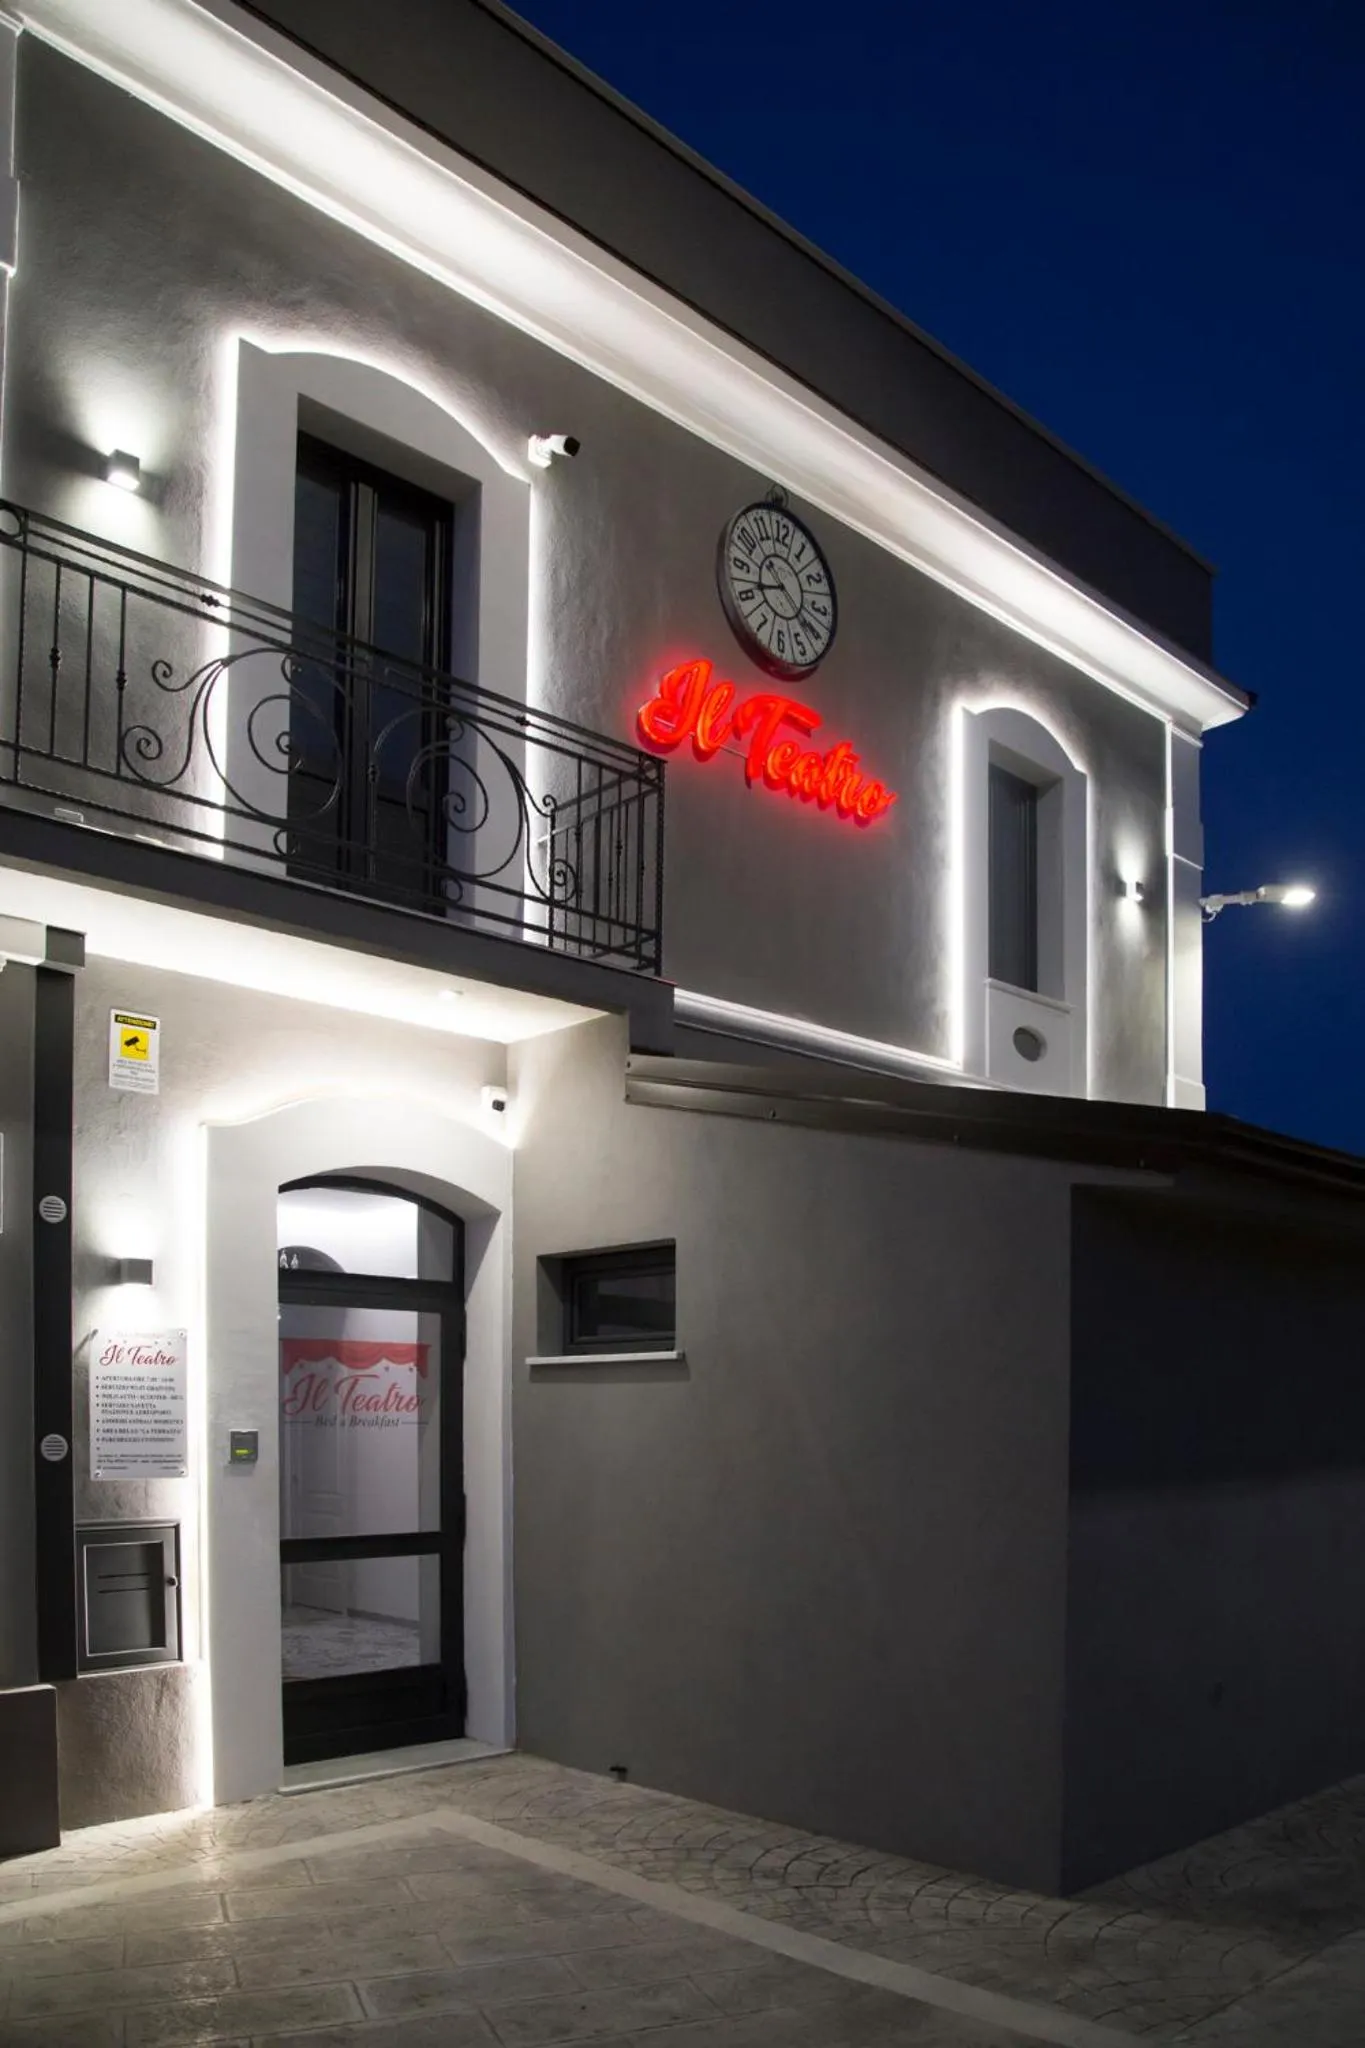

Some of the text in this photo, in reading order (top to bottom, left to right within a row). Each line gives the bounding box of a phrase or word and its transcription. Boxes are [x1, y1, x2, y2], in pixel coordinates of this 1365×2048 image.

[754, 517, 771, 541] 11
[775, 519, 790, 547] 12
[737, 528, 757, 556] 10
[794, 542, 806, 563] 1
[733, 557, 750, 574] 9
[806, 572, 822, 588] 2
[739, 590, 755, 602] 8
[811, 600, 827, 616] 3
[756, 613, 768, 632] 7
[777, 630, 785, 654] 6
[794, 632, 806, 657] 5
[637, 657, 898, 829] Il Teatro
[99, 1344, 179, 1367] Il Teatro
[282, 1373, 426, 1417] Il Teatro
[314, 1415, 337, 1427] Bed
[349, 1415, 400, 1430] Breakfast
